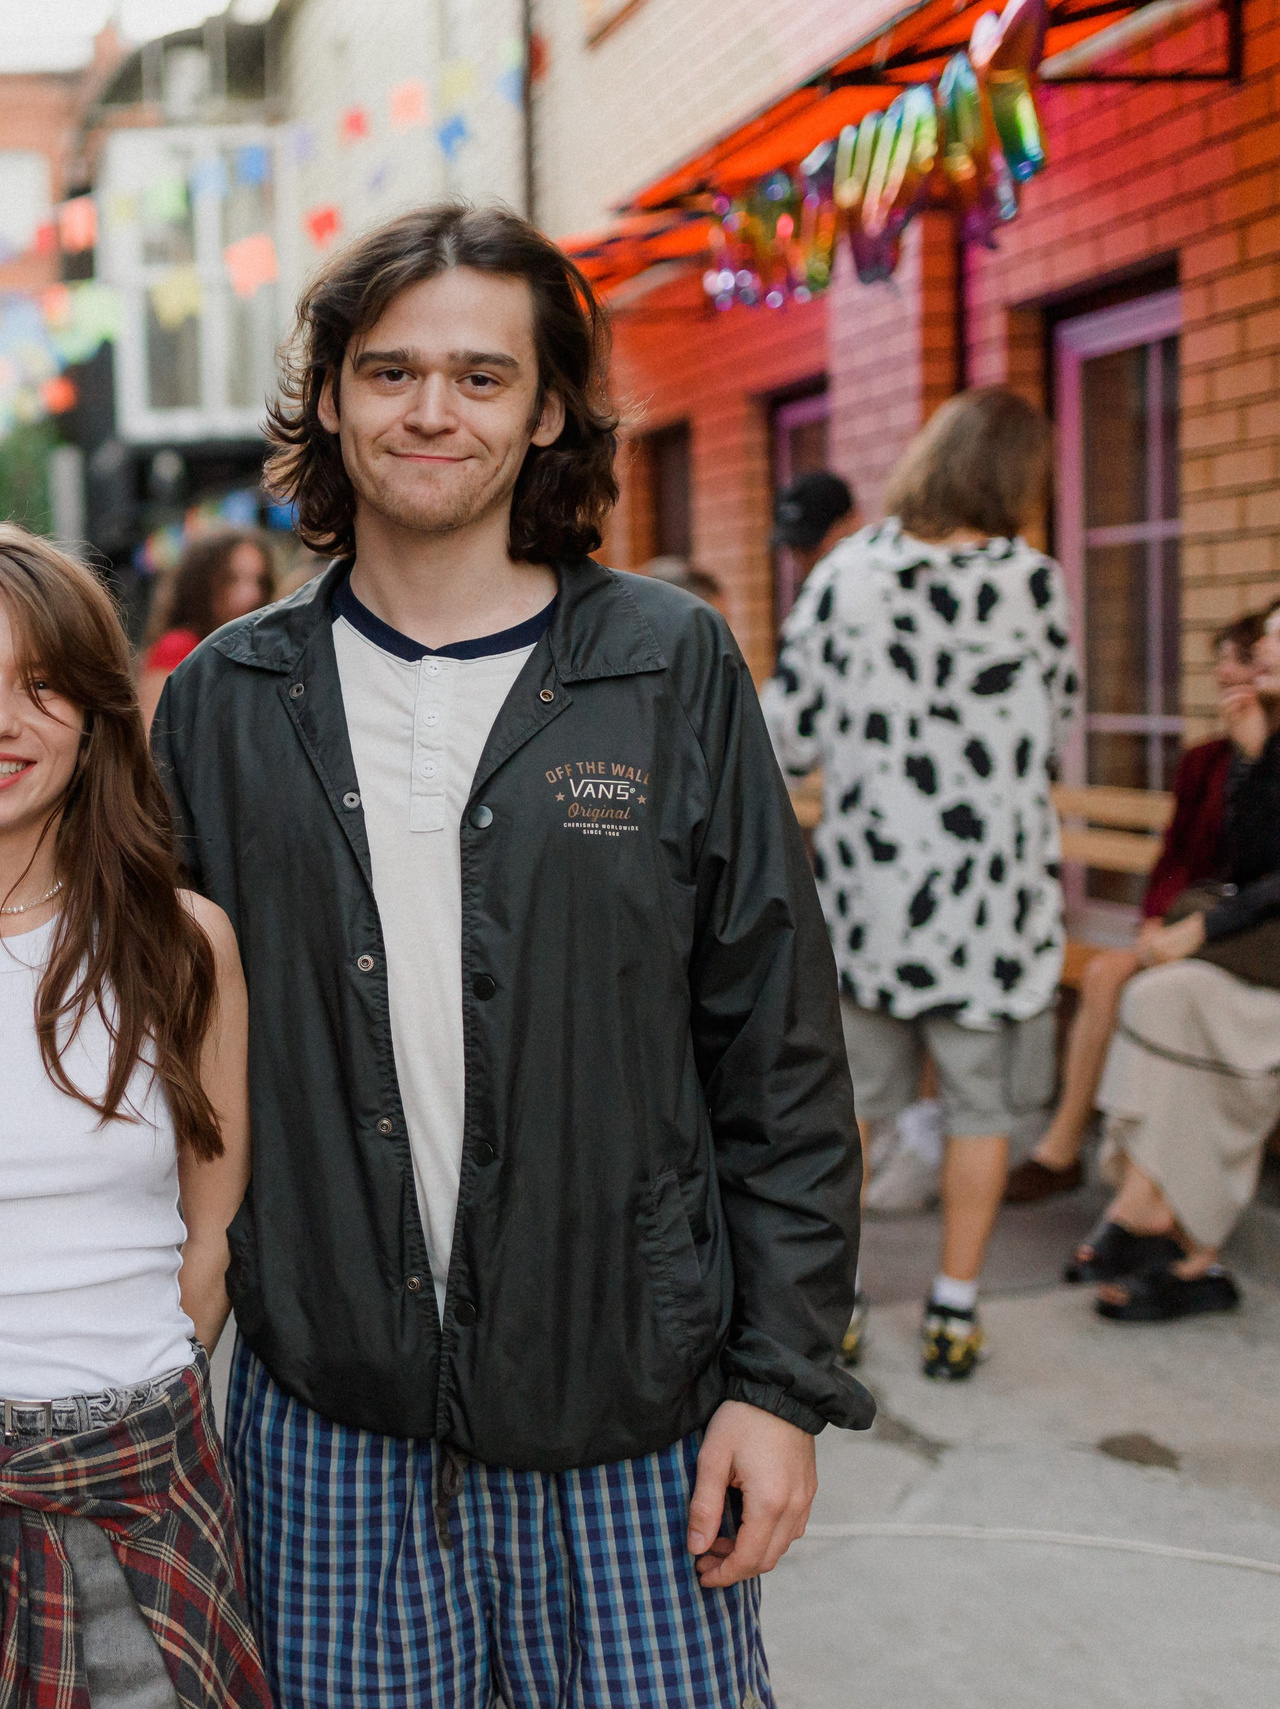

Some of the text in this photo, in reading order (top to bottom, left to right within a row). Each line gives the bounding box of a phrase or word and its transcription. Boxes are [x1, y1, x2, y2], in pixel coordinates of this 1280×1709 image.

[545, 761, 650, 786] OFF THE WALL
[567, 802, 631, 822] Original
[563, 822, 639, 831] CHERISHED WORLDWIDE
